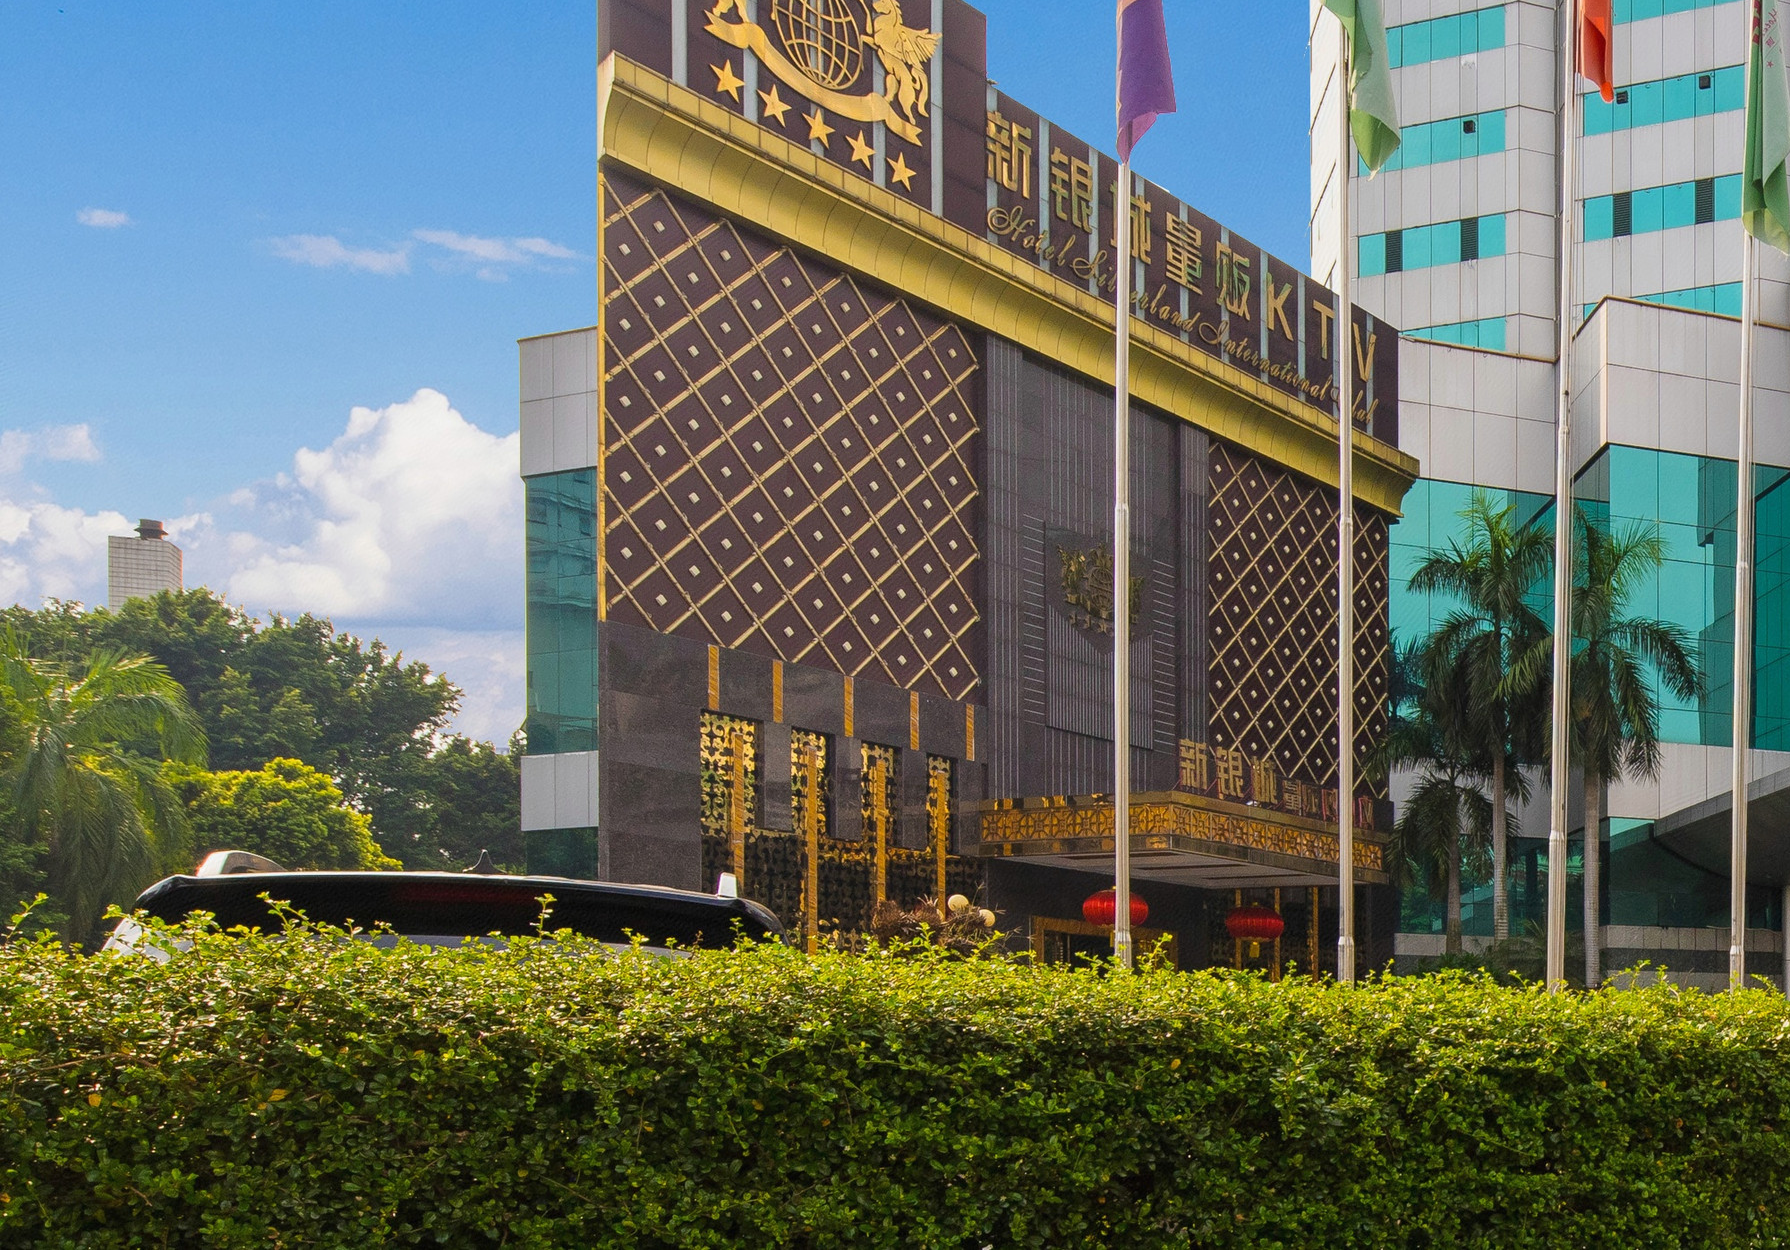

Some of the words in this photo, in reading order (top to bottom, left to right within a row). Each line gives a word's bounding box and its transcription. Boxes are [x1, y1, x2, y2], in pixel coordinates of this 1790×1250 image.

[987, 205, 1077, 267] Hotel
[1070, 249, 1202, 333] Silerland
[1198, 319, 1333, 401] International
